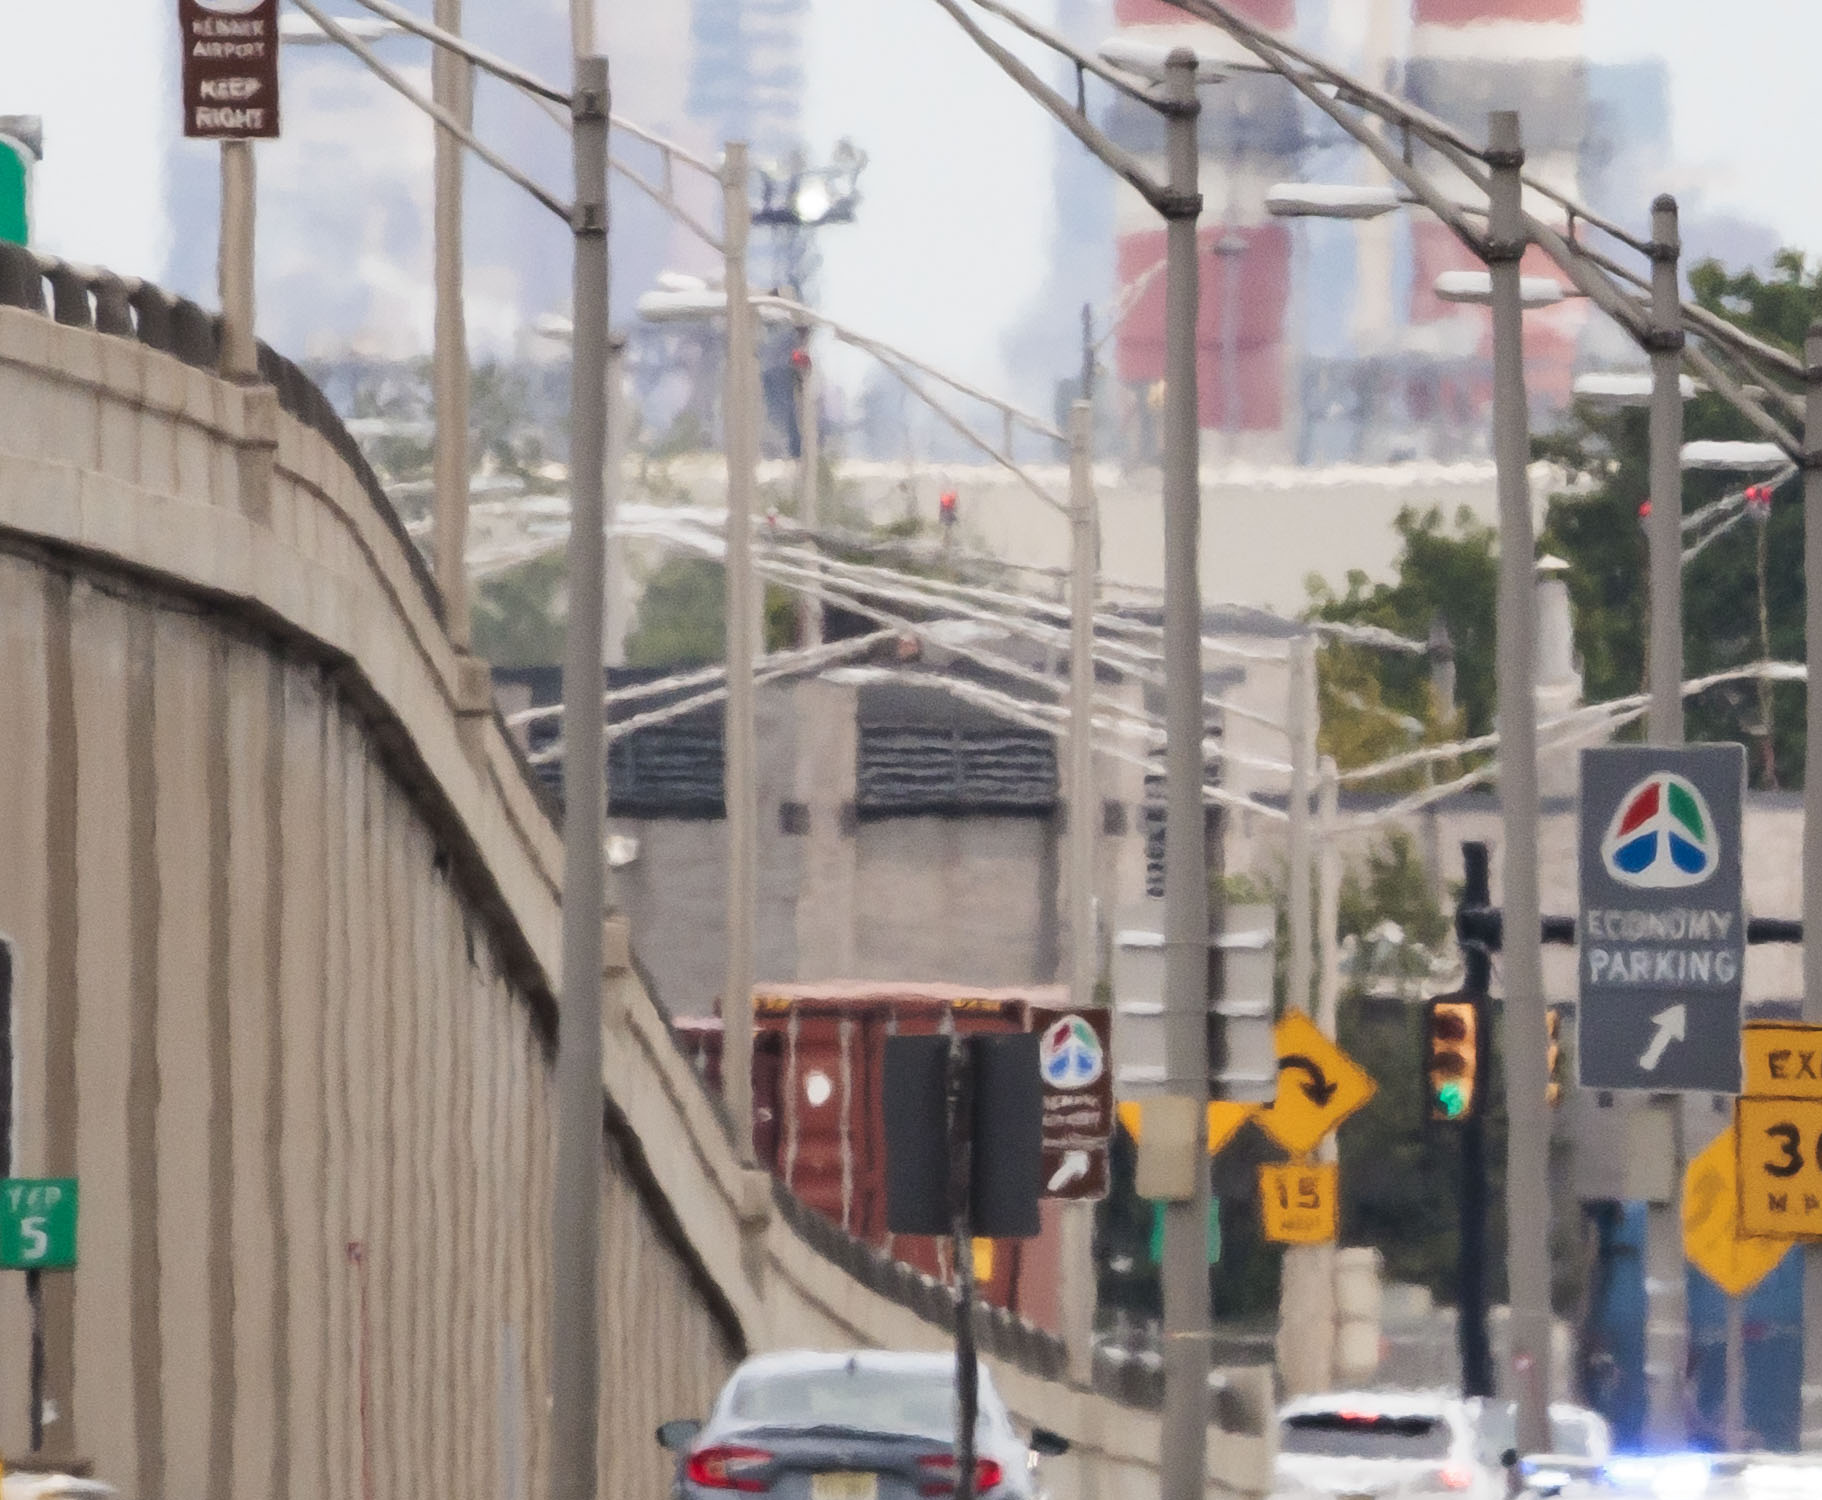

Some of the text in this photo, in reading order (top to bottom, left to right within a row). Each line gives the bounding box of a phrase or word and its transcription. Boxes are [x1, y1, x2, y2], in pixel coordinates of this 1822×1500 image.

[200, 78, 262, 100] KEEP
[195, 106, 264, 129] RIGHT
[1588, 949, 1736, 983] PARKING
[1276, 1177, 1320, 1210] 15
[21, 1217, 48, 1259] 5
